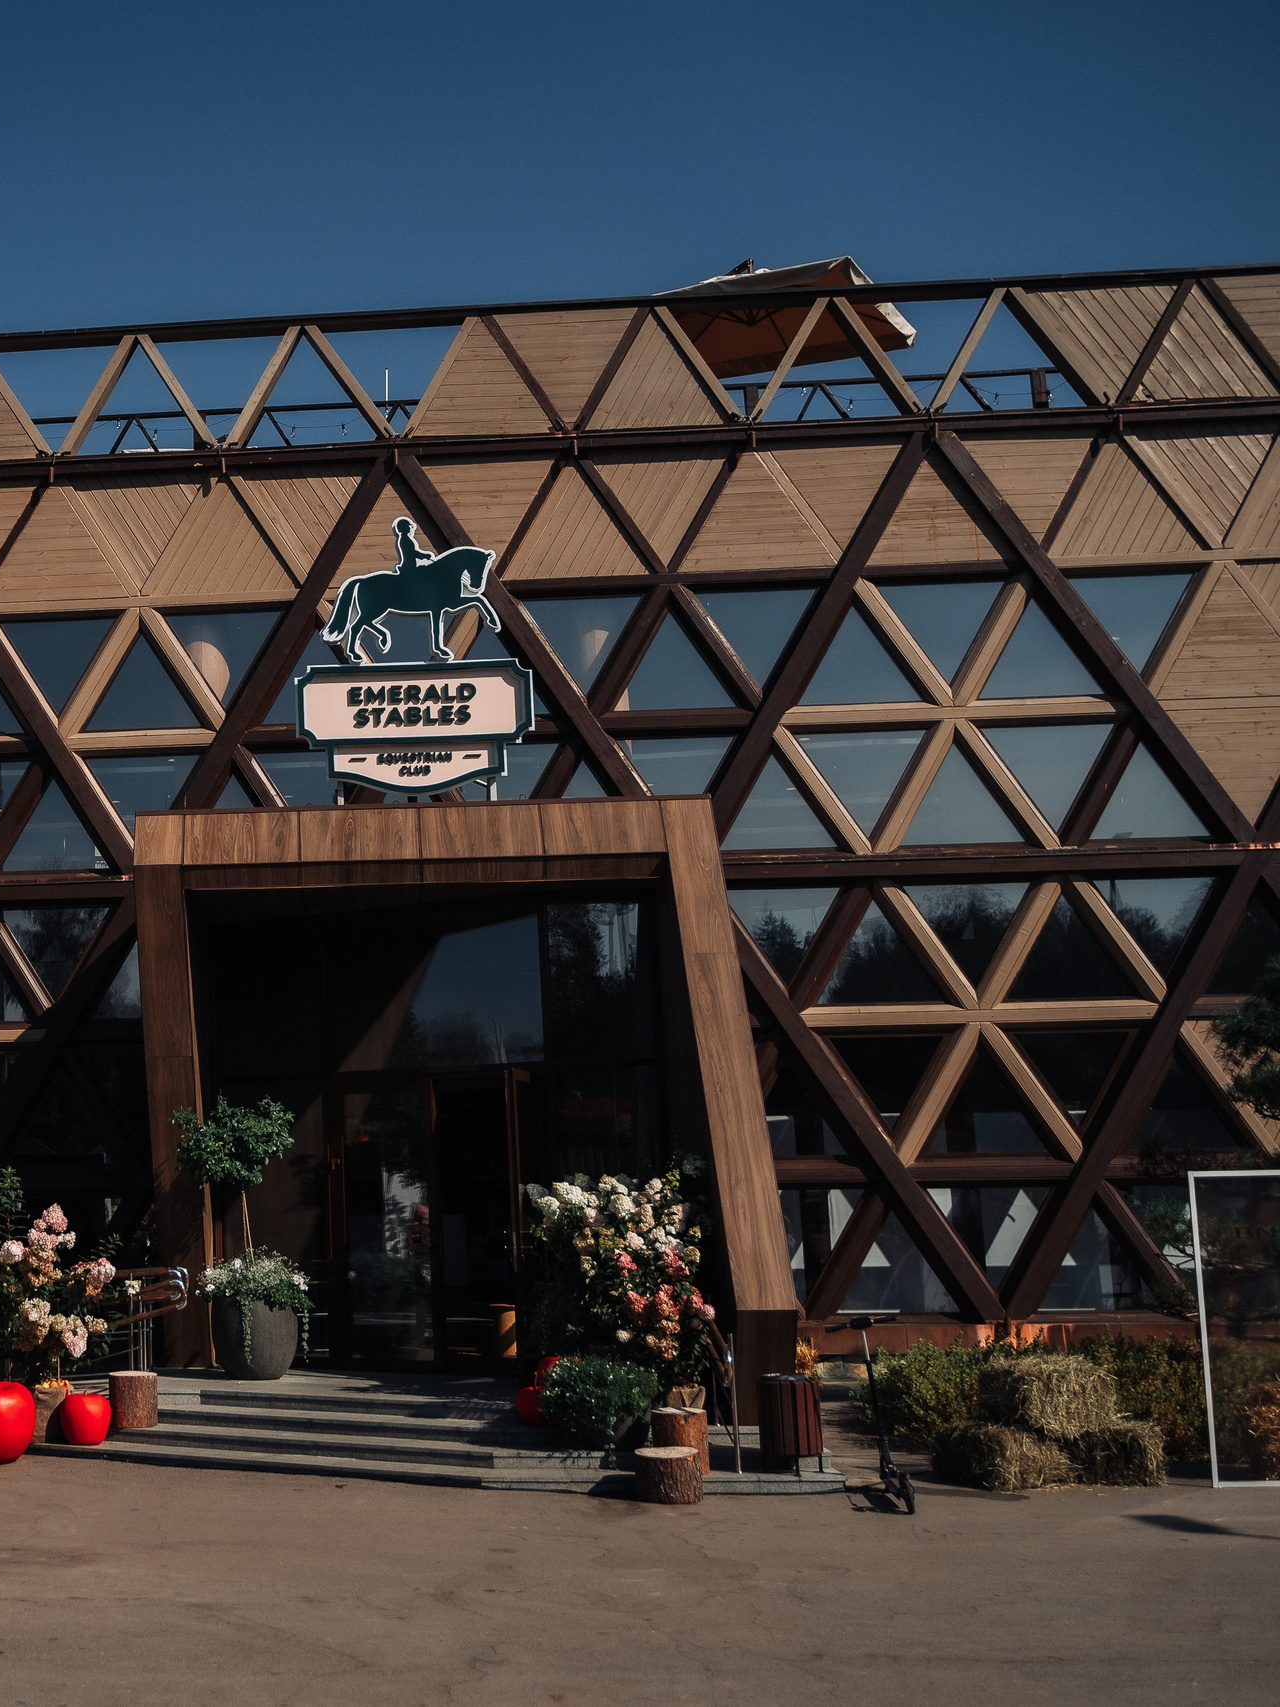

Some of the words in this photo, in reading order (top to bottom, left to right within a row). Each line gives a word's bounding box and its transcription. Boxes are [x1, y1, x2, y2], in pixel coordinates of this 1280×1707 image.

[346, 682, 477, 707] EMERALD
[352, 704, 472, 729] STABLES
[376, 751, 453, 766] EQUESTRIAN
[398, 764, 432, 777] CLUB
